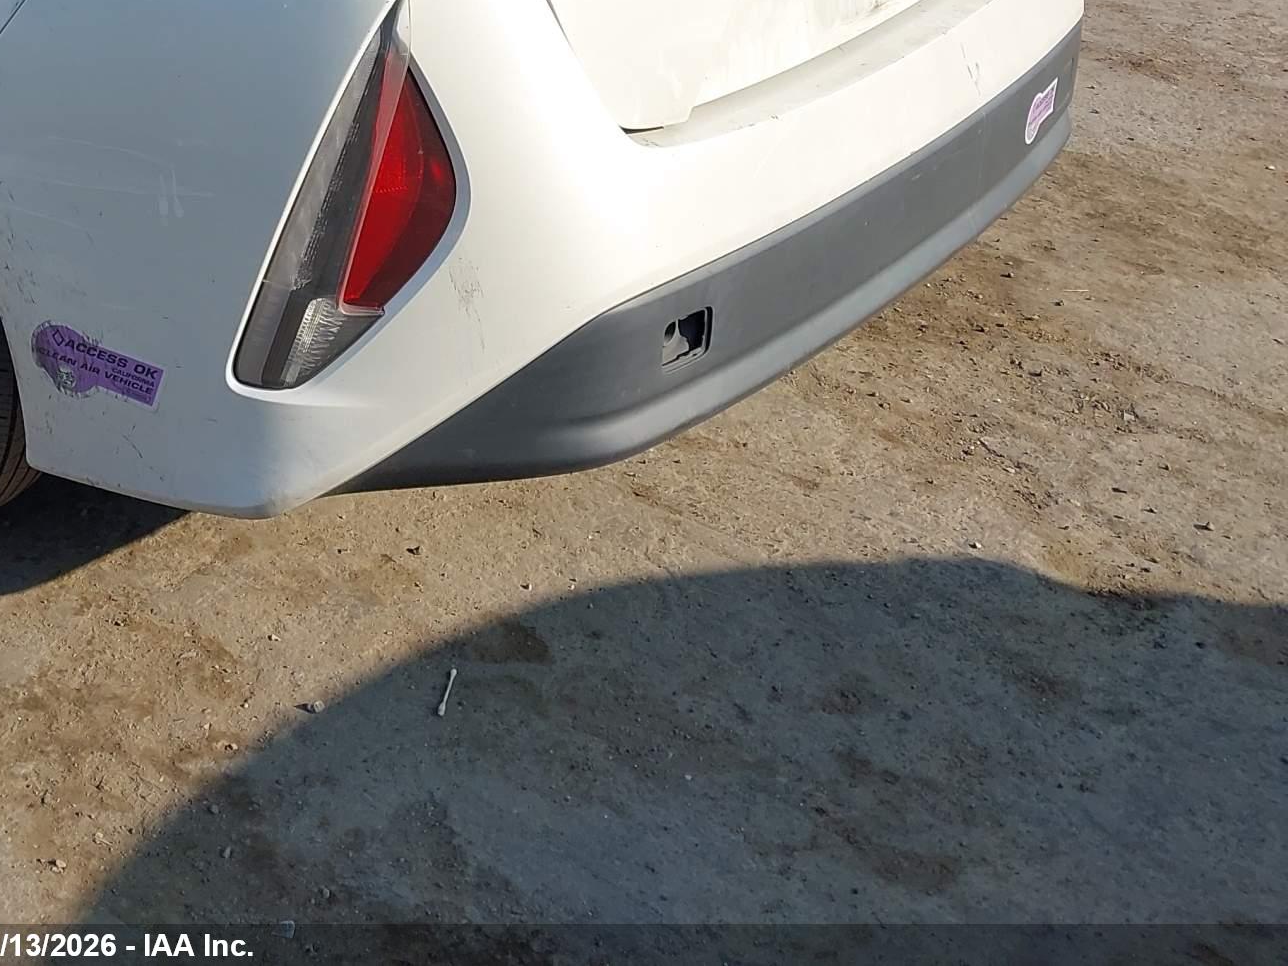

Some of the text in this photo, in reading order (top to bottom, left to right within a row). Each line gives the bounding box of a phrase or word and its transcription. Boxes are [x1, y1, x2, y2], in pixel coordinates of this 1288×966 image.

[38, 347, 154, 395] CLEAN AIR VEHICLE
[65, 338, 159, 380] ACCESS OK
[112, 367, 155, 388] CALIFORNIA
